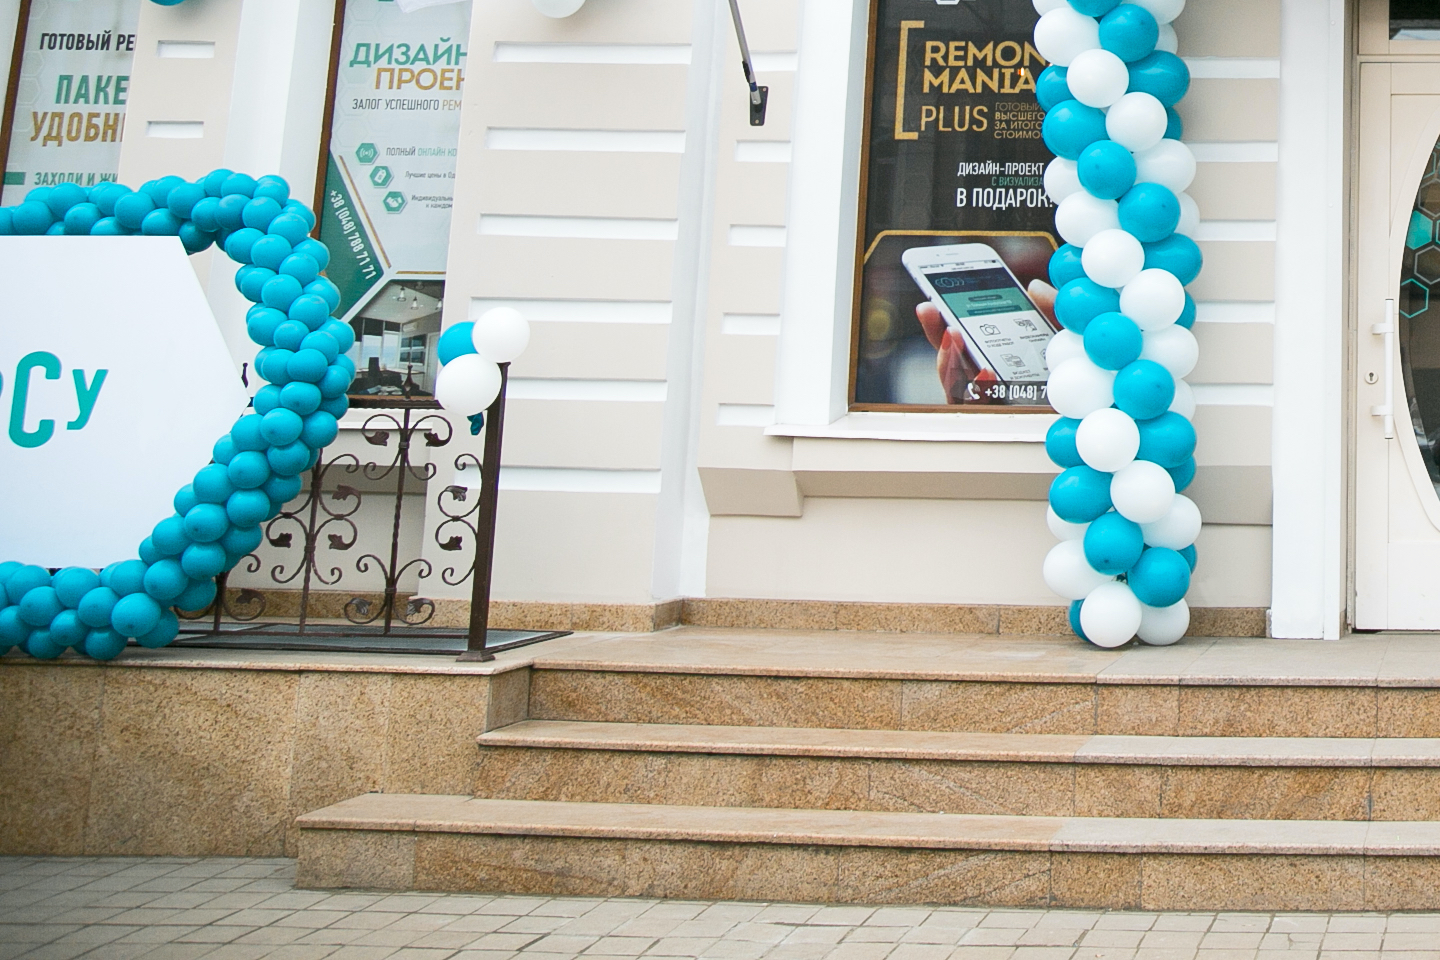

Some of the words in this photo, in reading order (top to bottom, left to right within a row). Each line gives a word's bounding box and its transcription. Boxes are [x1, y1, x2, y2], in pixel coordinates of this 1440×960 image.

[39, 30, 112, 51] ГОТОВЫЙ
[922, 67, 1037, 94] MANIA
[55, 74, 130, 105] ПАКЕ
[352, 98, 383, 110] ЗАЛОГ
[384, 99, 440, 111] УСПЕШНОГО
[920, 105, 989, 132] PLUS
[994, 112, 1046, 121] ВЫСШЕГО
[30, 111, 127, 148] УДОБН
[994, 121, 1007, 130] ЗА
[993, 130, 1044, 139] СТОИМО
[386, 146, 416, 157] ПОЛНЫЙ
[417, 147, 446, 157] ОНЛАЙН
[956, 160, 1045, 177] ДИЗАЙН-ПРОЕКТ
[330, 190, 346, 209] +38
[956, 188, 968, 207] В
[347, 231, 365, 253] 788
[355, 250, 371, 266] 71
[361, 264, 377, 280] 71
[984, 384, 1006, 399] +38
[1009, 384, 1037, 401] [048]
